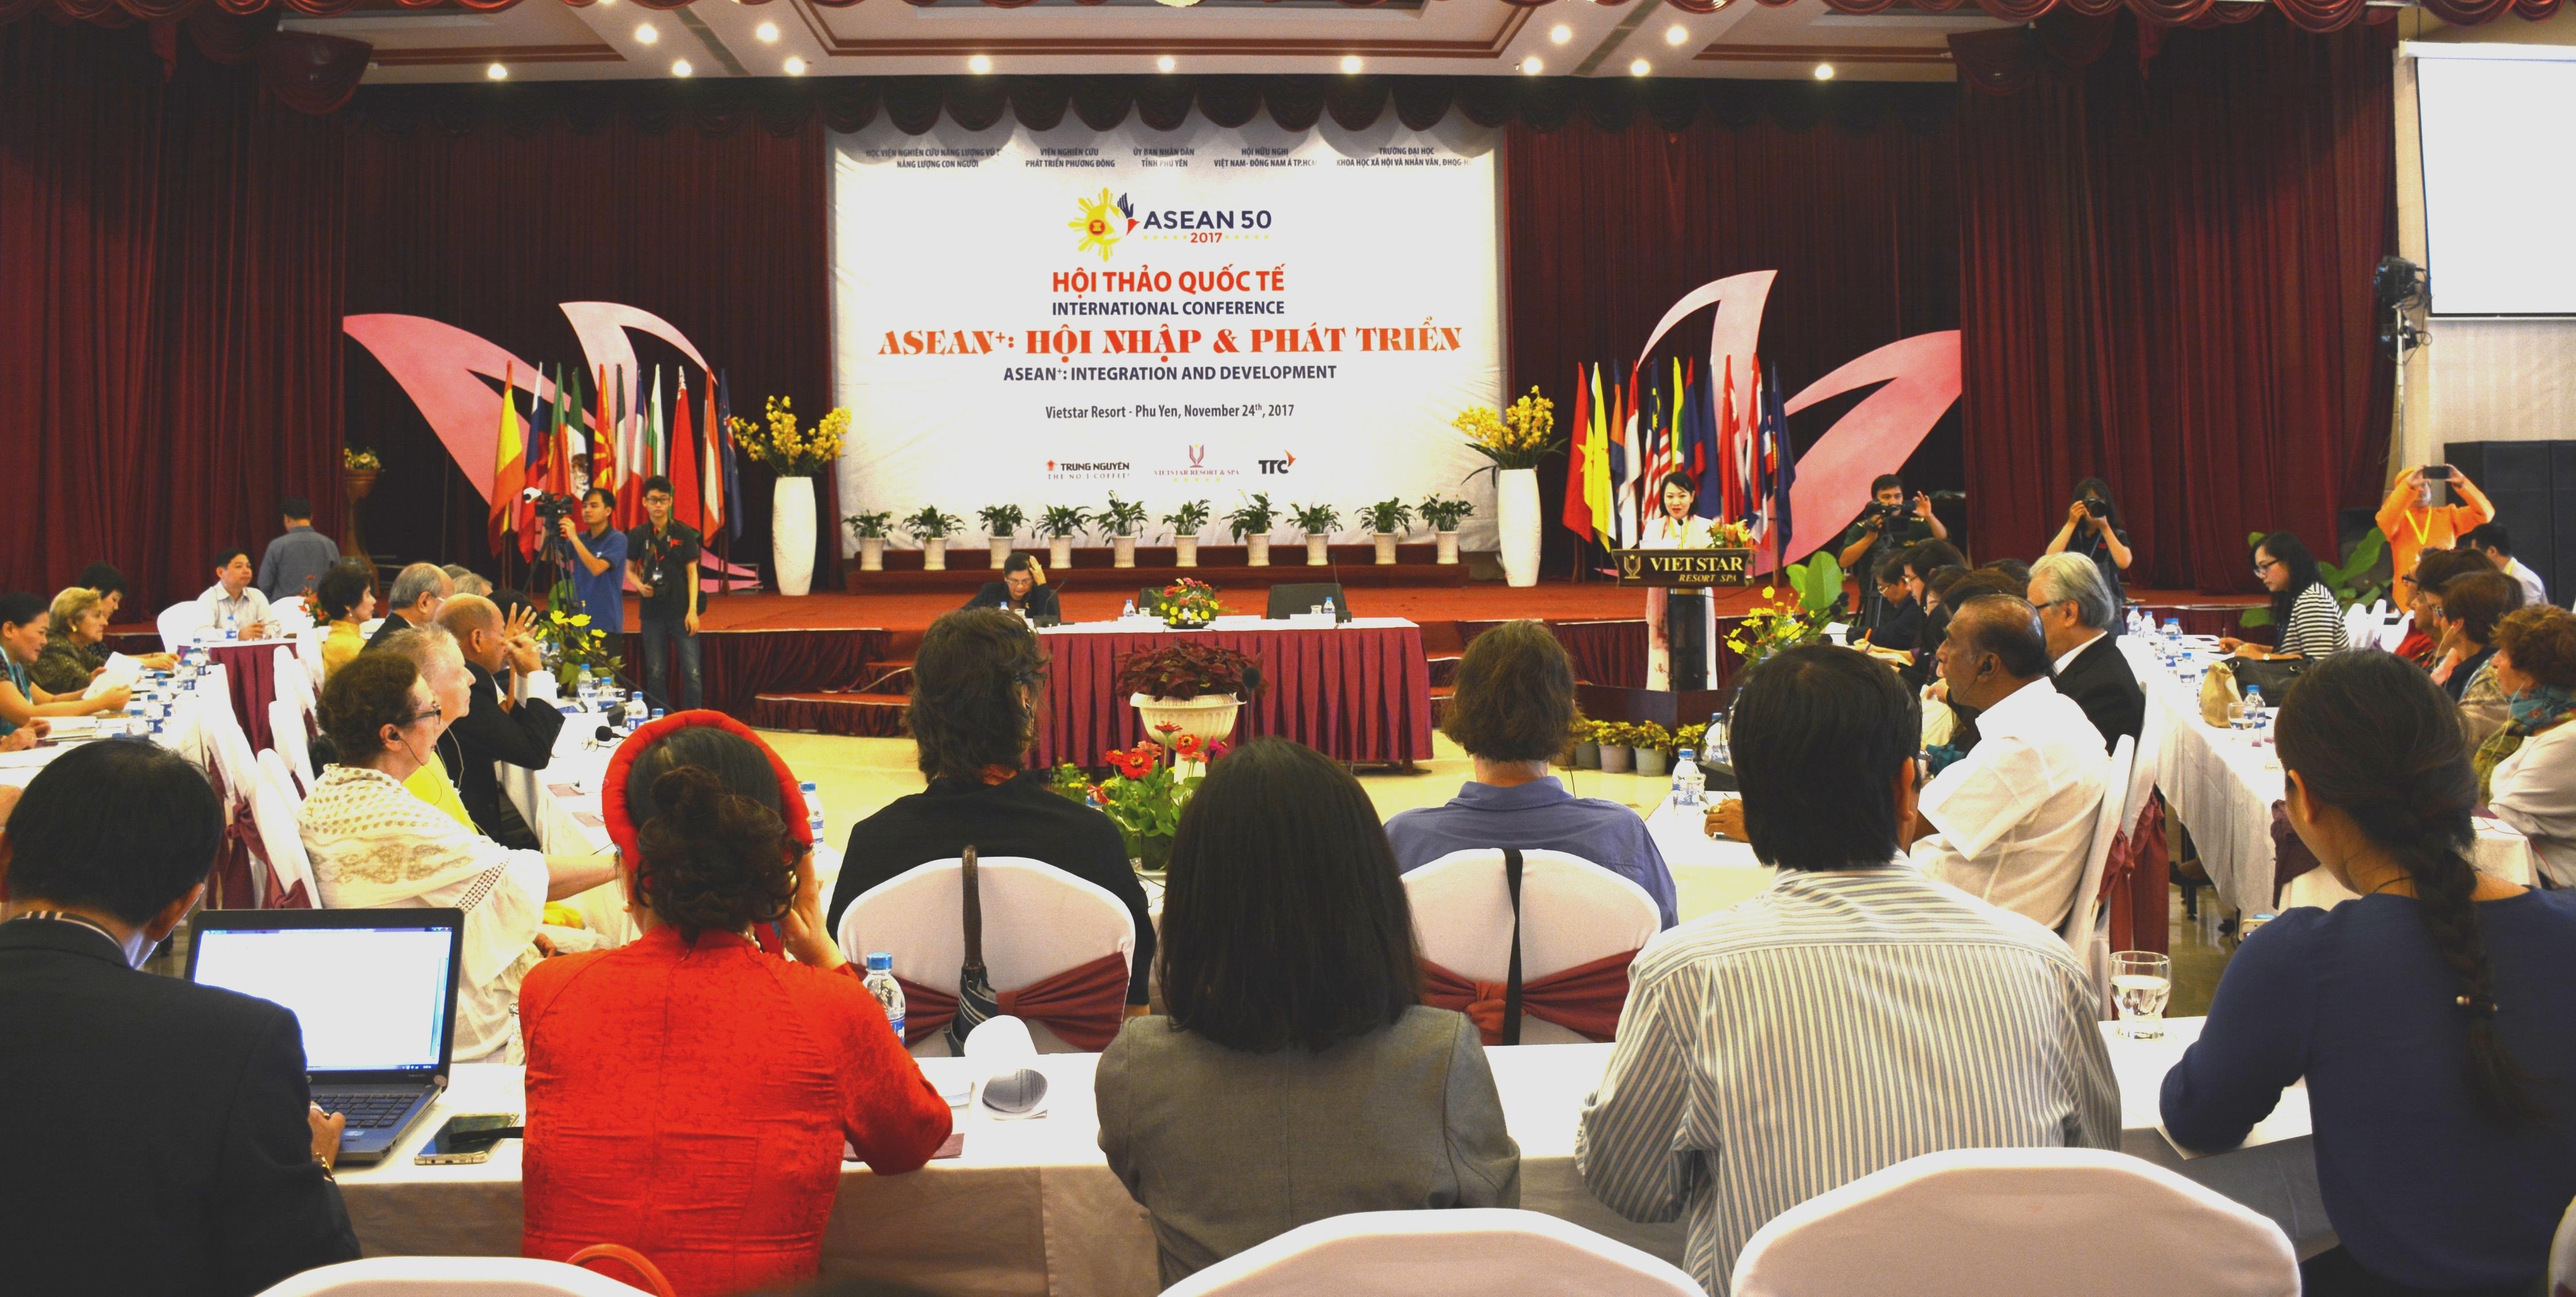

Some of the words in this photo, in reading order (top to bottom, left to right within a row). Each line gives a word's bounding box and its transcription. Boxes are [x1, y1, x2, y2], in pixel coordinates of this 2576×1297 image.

[881, 148, 896, 158] VIỆN
[898, 148, 924, 156] NGHIÊN
[1040, 148, 1056, 157] VIỆN
[1058, 147, 1083, 155] NGHIÊN
[1159, 147, 1179, 155] NHÂN
[1180, 147, 1194, 155] DÂN
[1242, 148, 1253, 156] HỘI
[1271, 148, 1289, 157] NGHỊ
[1408, 147, 1419, 156] ĐẠI
[1421, 147, 1434, 155] HỌC
[897, 159, 916, 167] NĂNG
[1026, 158, 1043, 167] PHÁT
[1096, 159, 1115, 167] ĐÔNG
[1175, 159, 1188, 167] YÊN
[1214, 159, 1228, 169] VIỆT
[1356, 159, 1369, 168] HỌC
[1371, 158, 1380, 166] XÃ
[1381, 158, 1393, 168] HỘI
[1395, 158, 1403, 166] VÀ
[1405, 158, 1423, 166] NHÂN
[1143, 210, 1234, 229] ASEAN
[1241, 210, 1272, 229] 50
[1191, 232, 1223, 243] 2017
[1053, 267, 1097, 299] HỘI
[1102, 264, 1172, 292] THẢO
[1178, 264, 1251, 295] QUỐC
[1255, 263, 1285, 291] TẾ
[1053, 301, 1179, 316] INTERNATIONAL
[1182, 301, 1285, 315] CONFERENCE
[1026, 323, 1092, 363] HỘI
[1102, 323, 1201, 363] NHẬP
[1213, 328, 1240, 354] &
[1251, 322, 1346, 352] PHÁT
[1356, 316, 1462, 352] TRIỂN
[1071, 366, 1177, 381] INTEGRATION
[1181, 366, 1216, 380] AND
[1220, 365, 1337, 380] DEVELOPMENT
[1046, 406, 1089, 419] Vietstar
[1091, 405, 1126, 418] Resort
[1136, 404, 1156, 417] Phu
[1158, 405, 1181, 419] Yen,
[1184, 403, 1240, 417] November
[1269, 404, 1294, 417] 2017
[1061, 463, 1091, 471] TRUNG
[1093, 461, 1130, 471] NGUYÊN
[1258, 459, 1289, 475] TTC
[1650, 557, 1694, 571] VIET
[1697, 557, 1743, 571] STAR
[1679, 574, 1716, 582] RESORT
